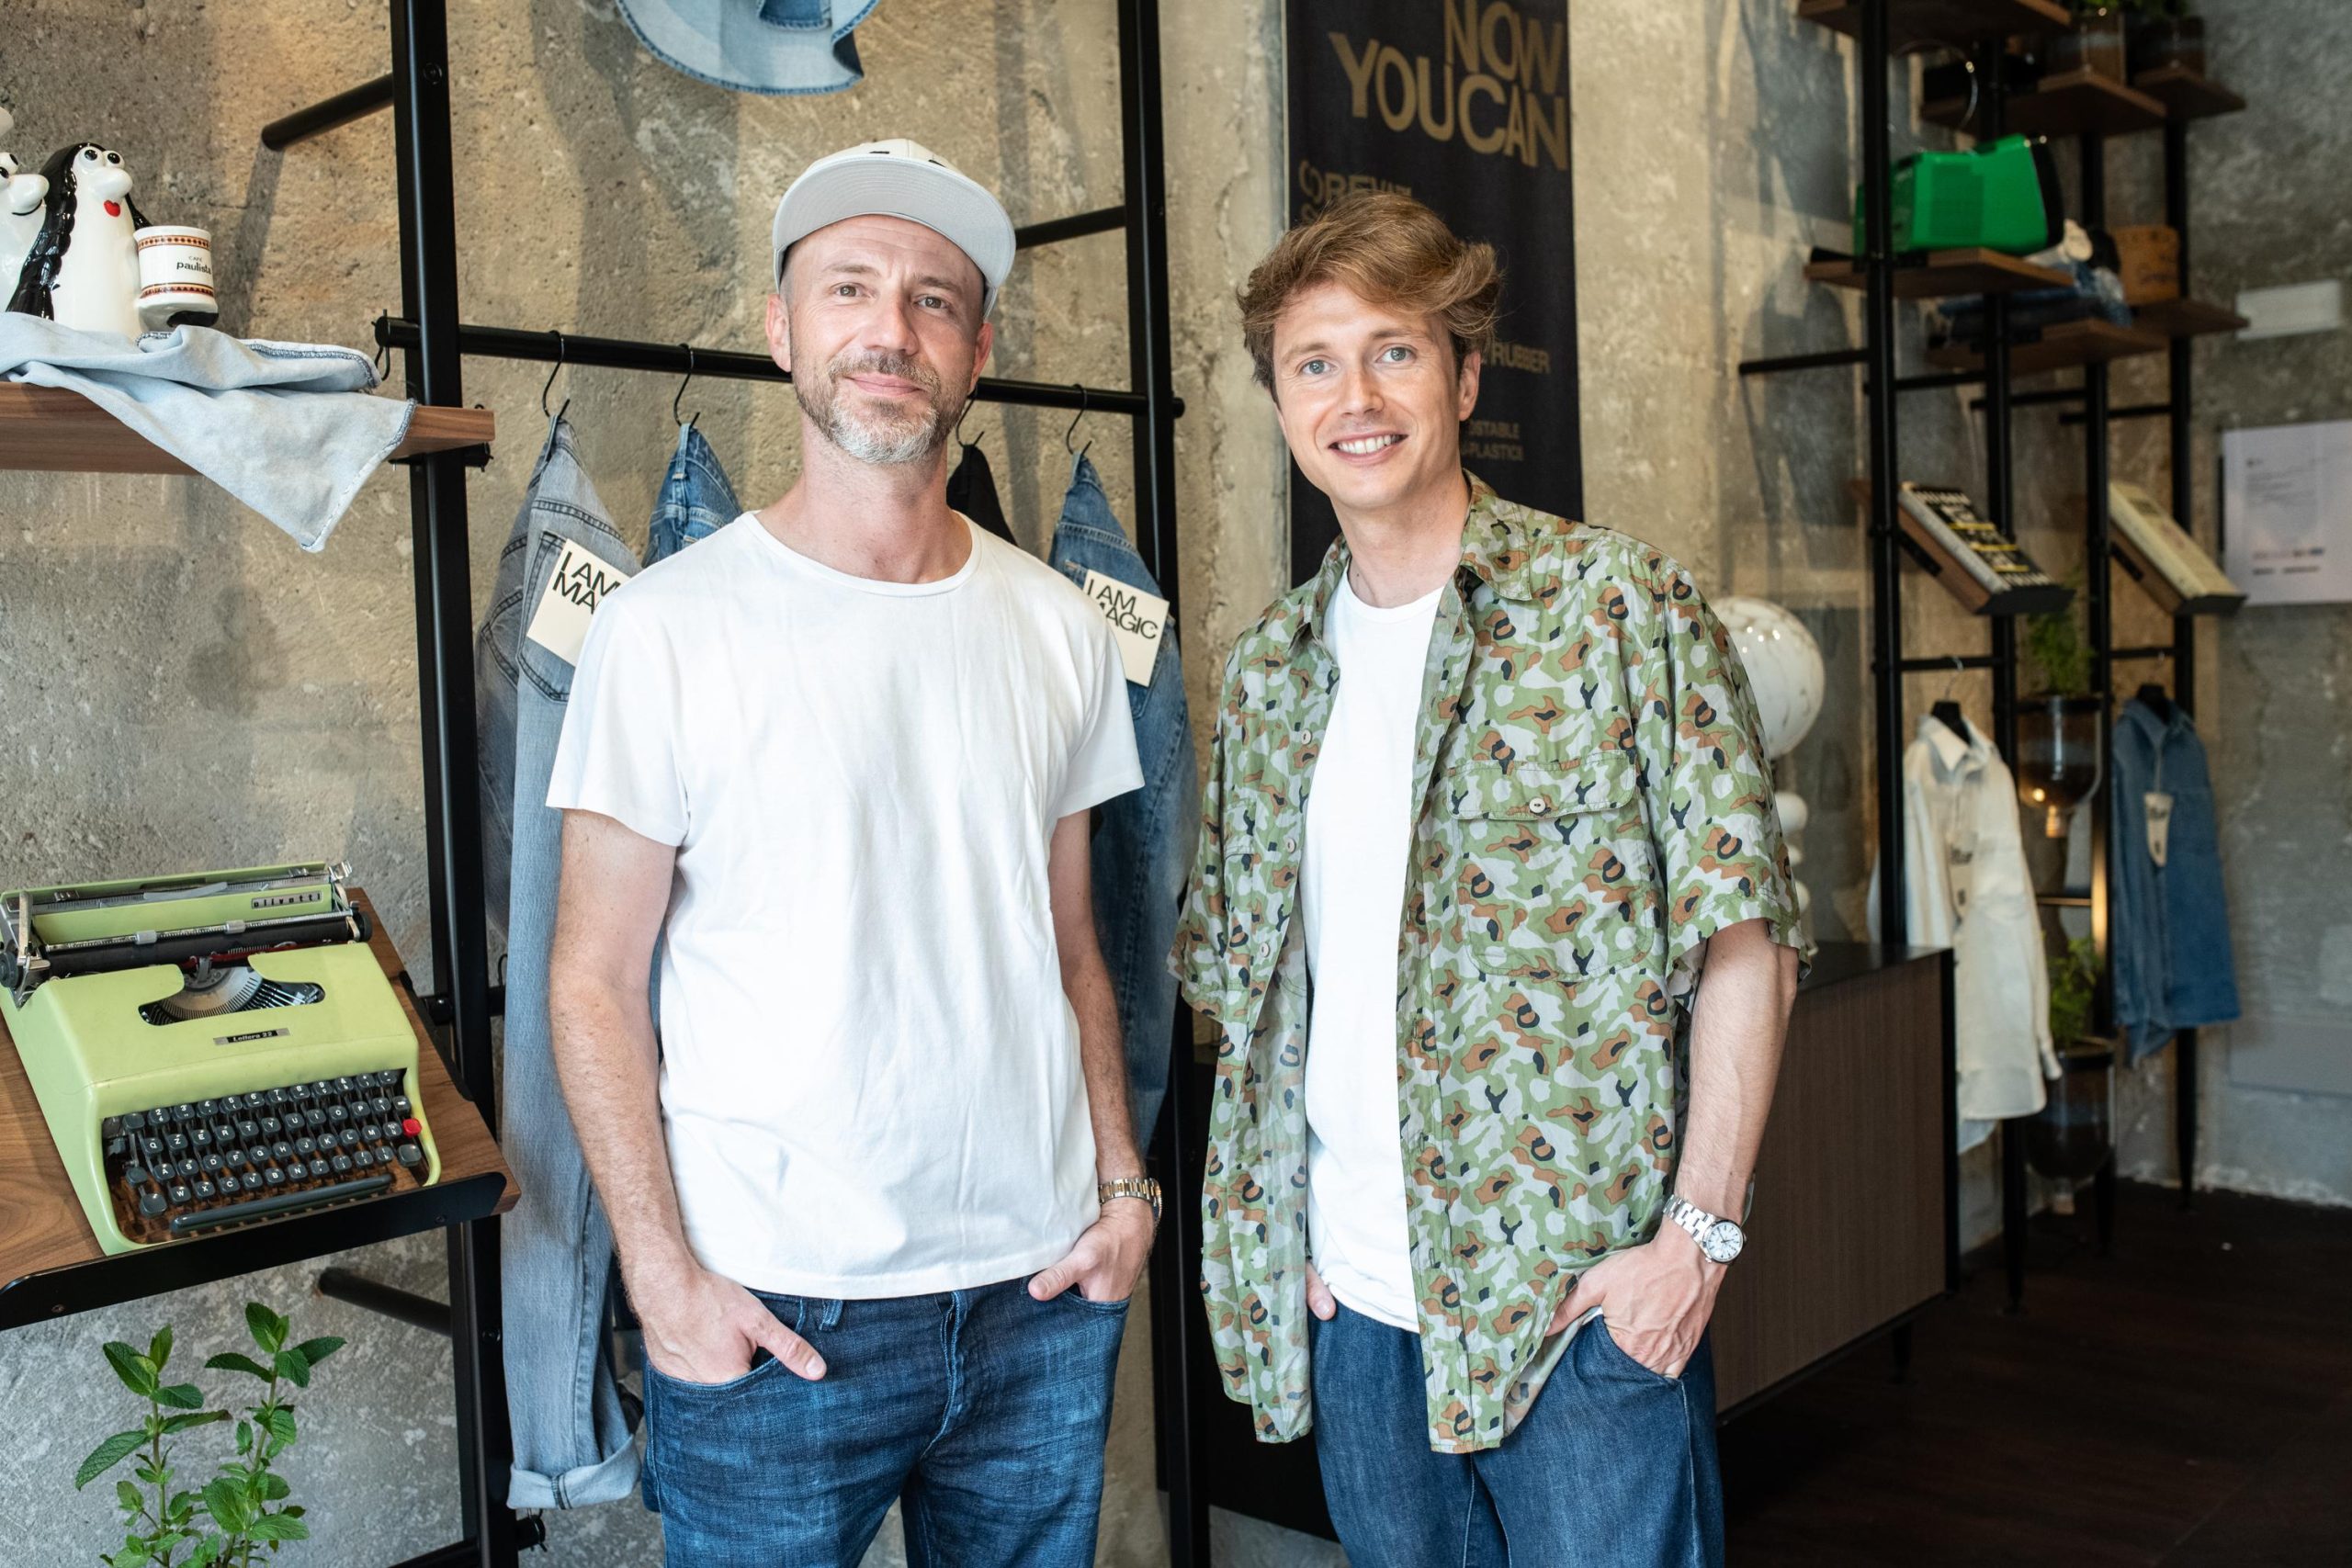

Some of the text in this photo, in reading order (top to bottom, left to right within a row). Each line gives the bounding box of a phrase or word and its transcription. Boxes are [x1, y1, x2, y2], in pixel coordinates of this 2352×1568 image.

[1444, 0, 1563, 94] NOW
[1329, 32, 1569, 171] YOU CAN
[552, 571, 600, 615] MA
[561, 551, 621, 597] I AM
[1087, 579, 1136, 614] I AM
[254, 893, 321, 908] olivetti
